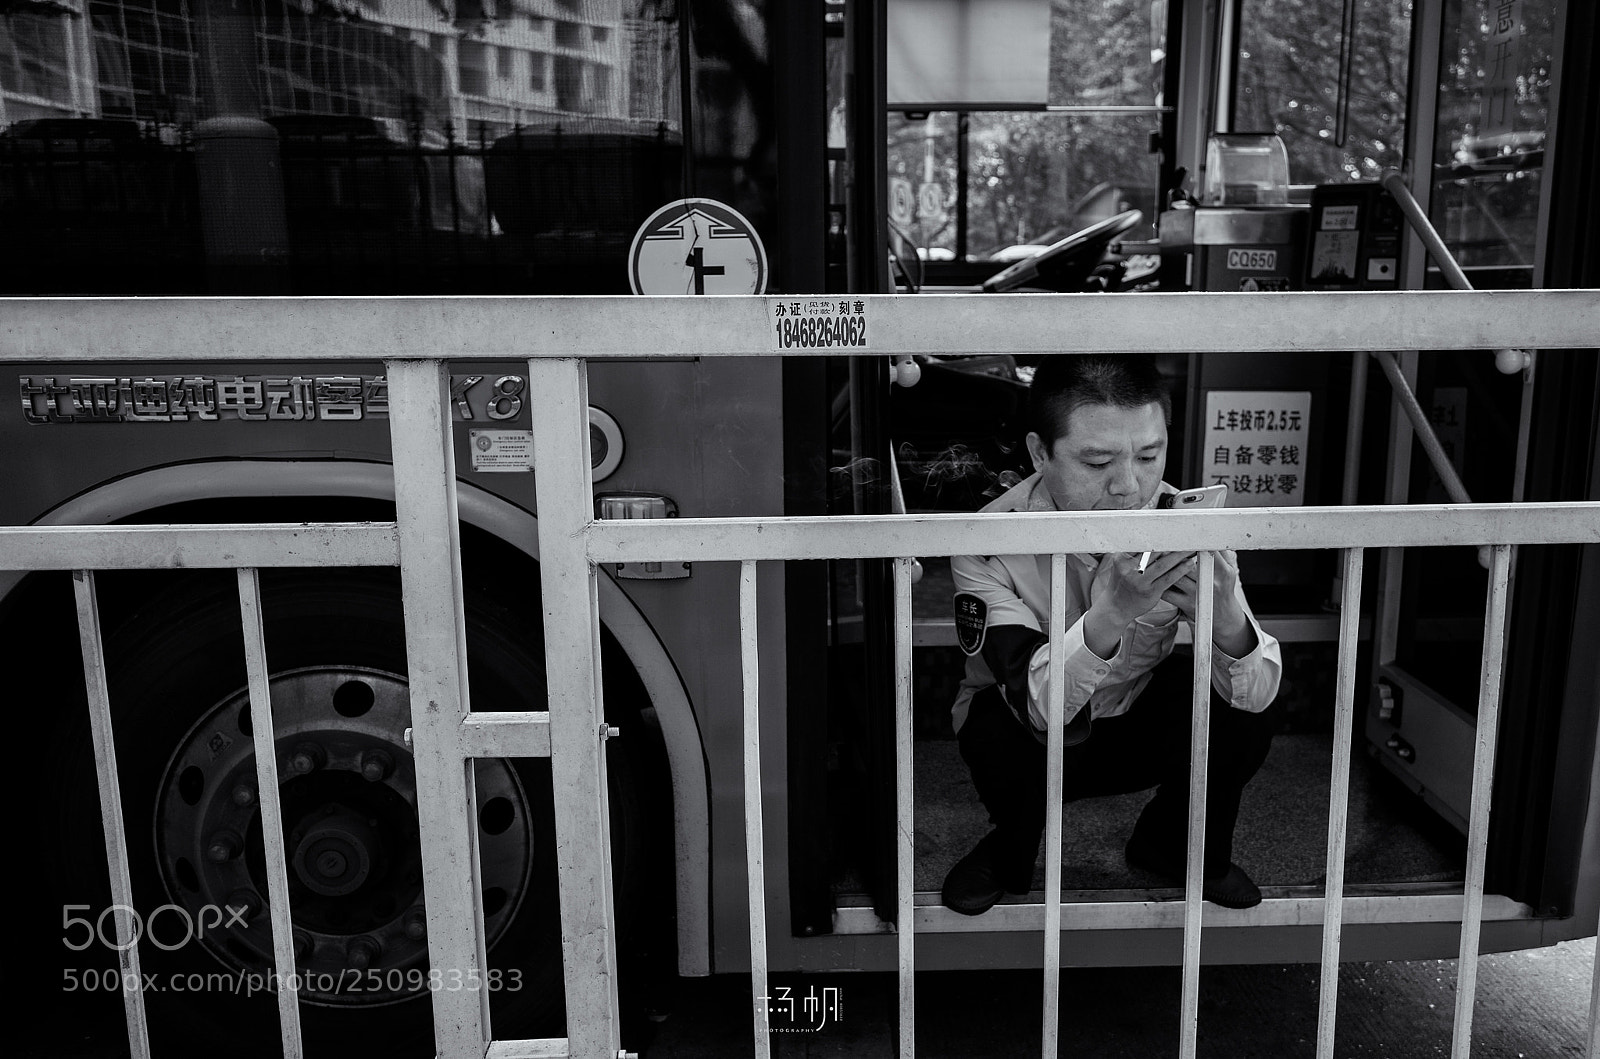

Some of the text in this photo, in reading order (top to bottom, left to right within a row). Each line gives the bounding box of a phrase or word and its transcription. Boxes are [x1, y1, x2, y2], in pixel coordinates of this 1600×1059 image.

[1229, 251, 1275, 268] CQ650
[776, 316, 866, 349] 18468264062
[1212, 409, 1302, 431] 上车投币2.5元
[1213, 444, 1299, 465] 自备零钱
